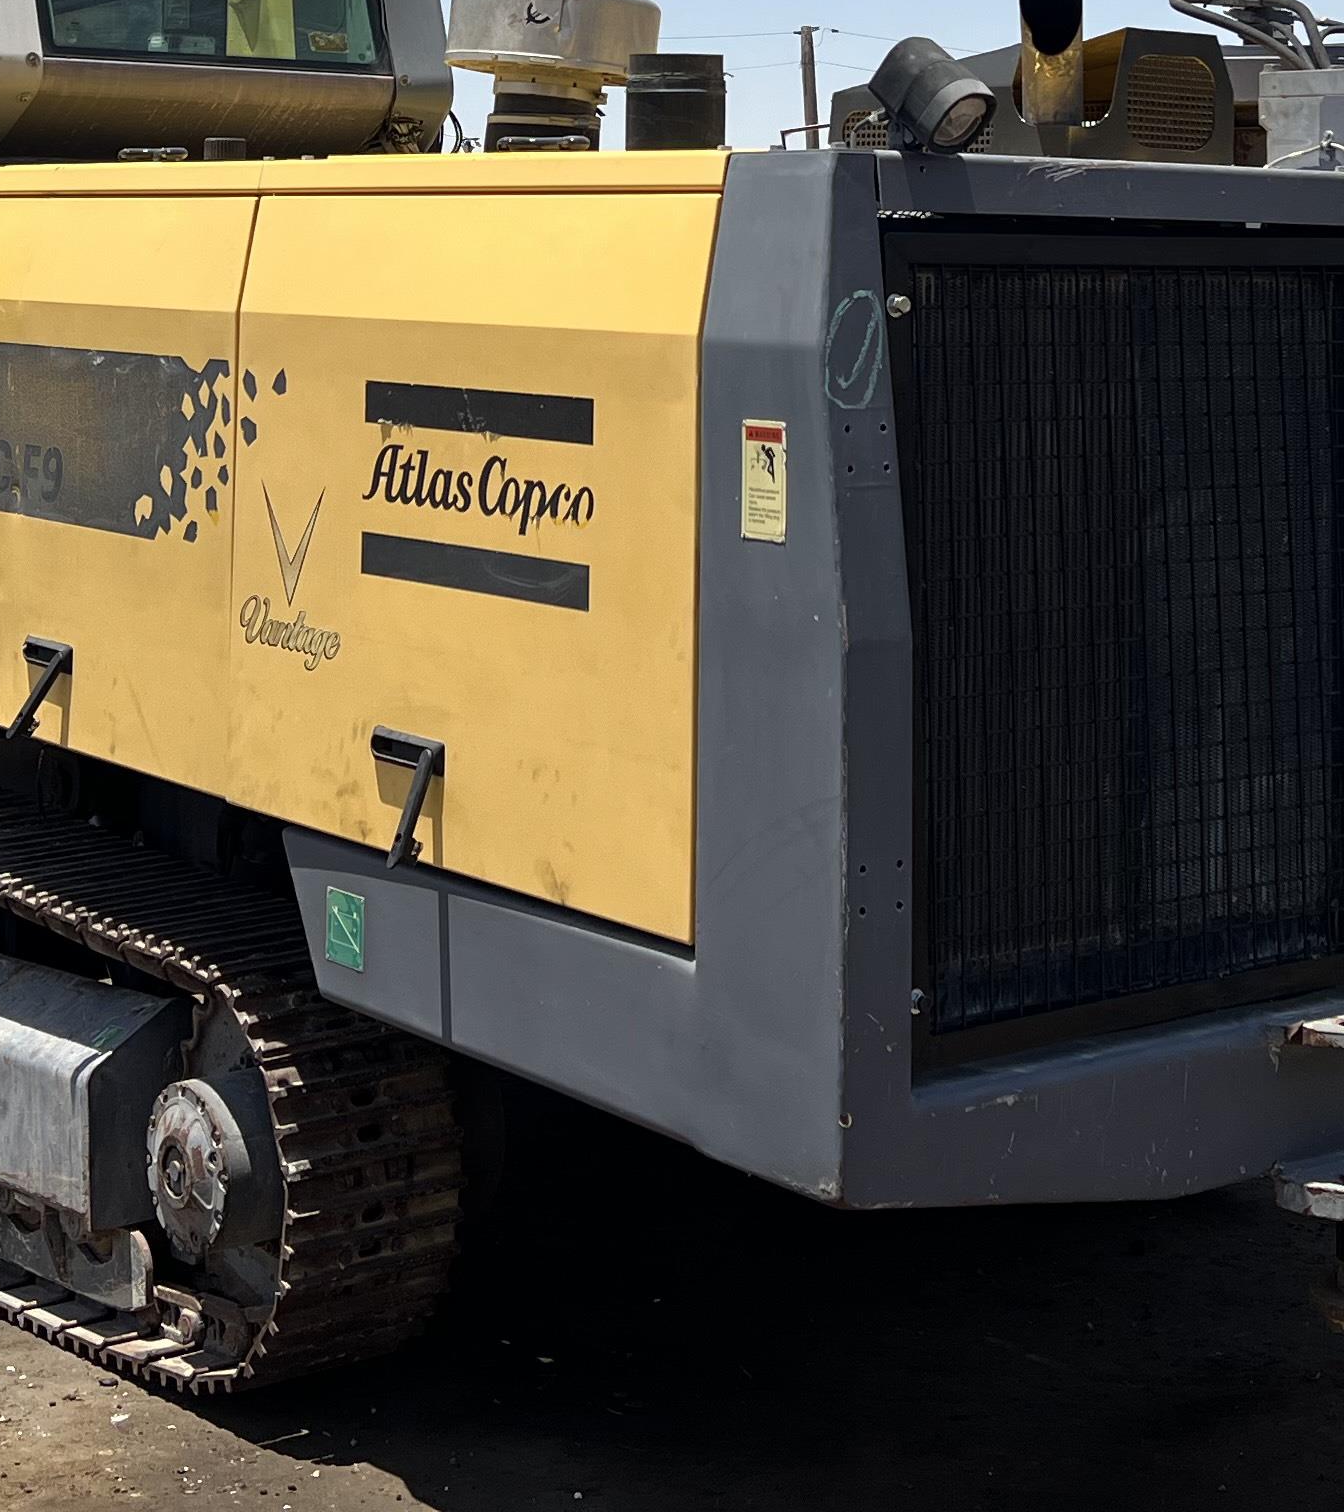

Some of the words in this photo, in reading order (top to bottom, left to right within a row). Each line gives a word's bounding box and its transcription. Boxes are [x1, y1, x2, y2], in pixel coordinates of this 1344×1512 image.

[23, 444, 64, 503] F9
[362, 444, 473, 513] Atlas
[478, 455, 594, 536] Copco
[239, 594, 341, 672] Vantage
